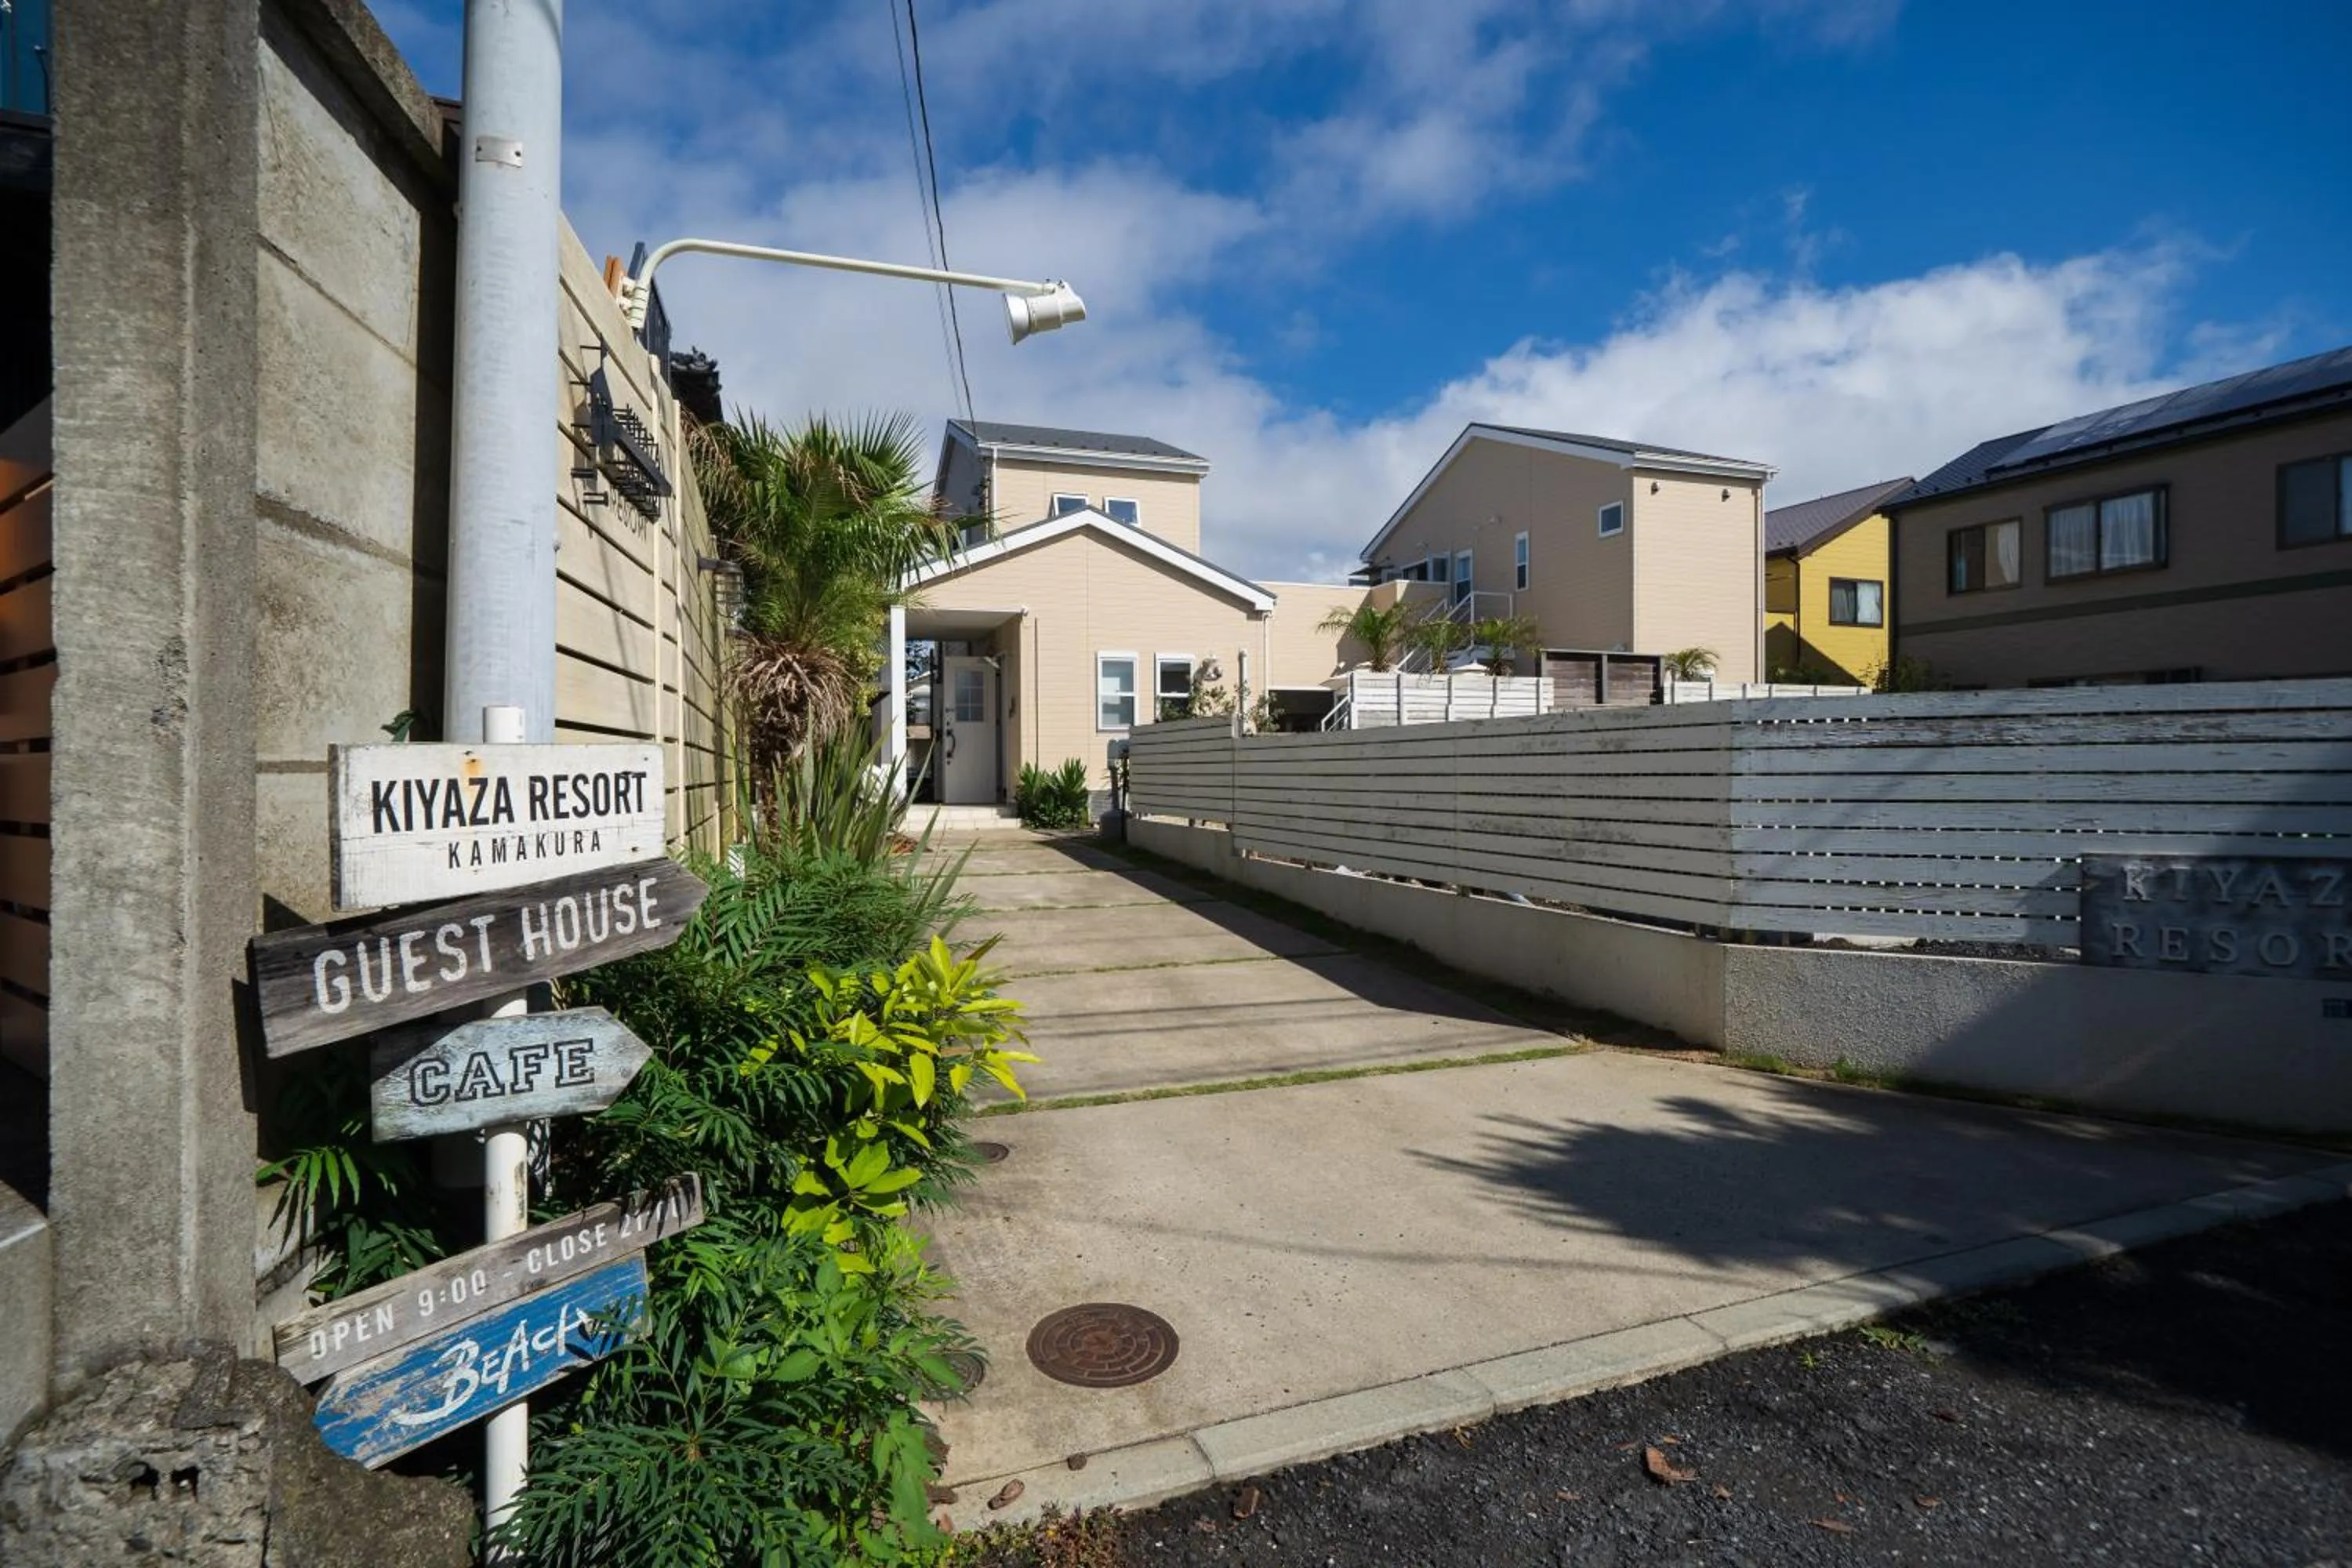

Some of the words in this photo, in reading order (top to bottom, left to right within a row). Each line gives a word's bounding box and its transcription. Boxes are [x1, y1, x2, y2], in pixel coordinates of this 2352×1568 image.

[372, 777, 515, 833] KIYAZA
[529, 771, 647, 821] RESORT
[449, 830, 601, 869] KAMAKURA
[2121, 863, 2346, 907] KIYAZ
[314, 914, 495, 1014] GUEST
[521, 877, 662, 961] HOUSE
[409, 1037, 596, 1107] CAFE
[310, 1303, 394, 1360] OPEN
[418, 1269, 487, 1317] 9:00
[528, 1222, 608, 1274] CLOSE
